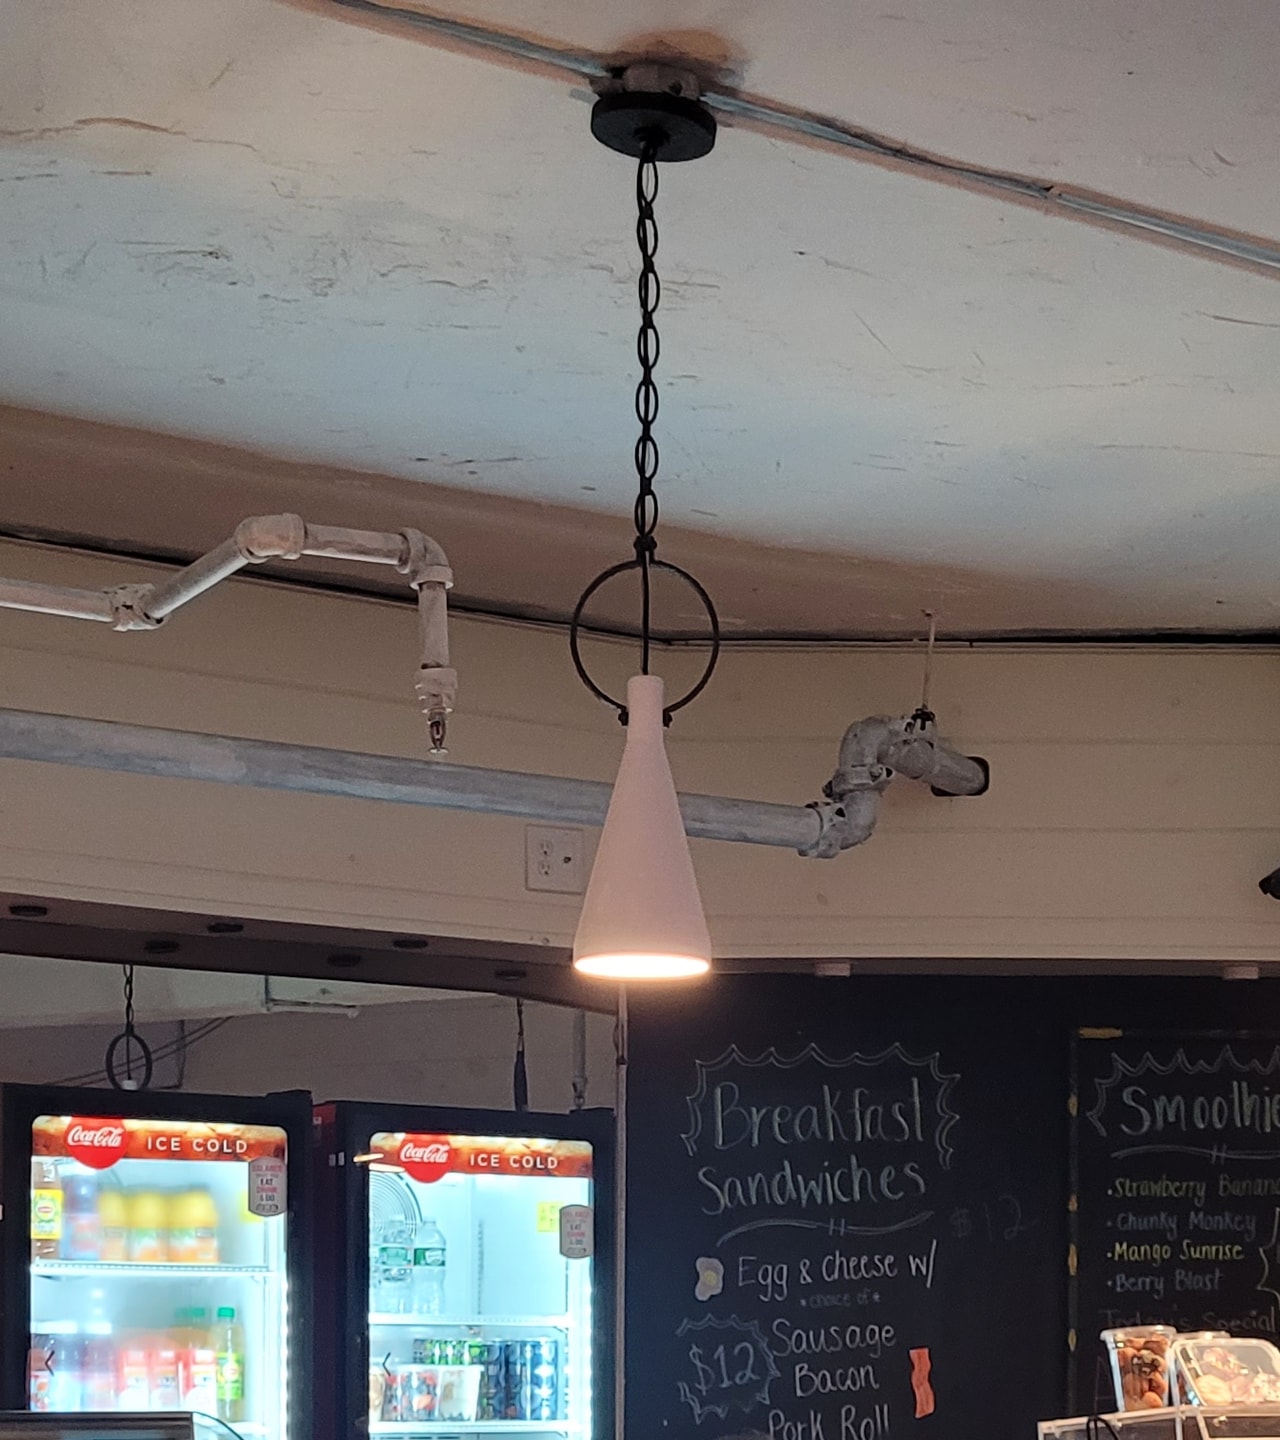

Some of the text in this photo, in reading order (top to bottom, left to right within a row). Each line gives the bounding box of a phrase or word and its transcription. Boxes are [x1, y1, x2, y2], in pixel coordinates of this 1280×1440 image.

[714, 1076, 924, 1150] Breakfast
[67, 1125, 248, 1154] Coca-Cola ICE COLD
[400, 1142, 559, 1170] Coca-Cola ICE COLD
[698, 1153, 926, 1216] Sandwiches
[1114, 1173, 1207, 1207] Strawberry
[1116, 1210, 1257, 1241] Chunky Monkey
[1113, 1238, 1245, 1267] Mango Sunrise
[738, 1256, 788, 1302] Egg
[799, 1258, 813, 1285] &
[908, 1238, 937, 1289] w/
[1115, 1266, 1224, 1300] Berry Blast
[772, 1318, 897, 1359] Sausage
[688, 1341, 761, 1397] $12
[794, 1363, 879, 1398] Bacon
